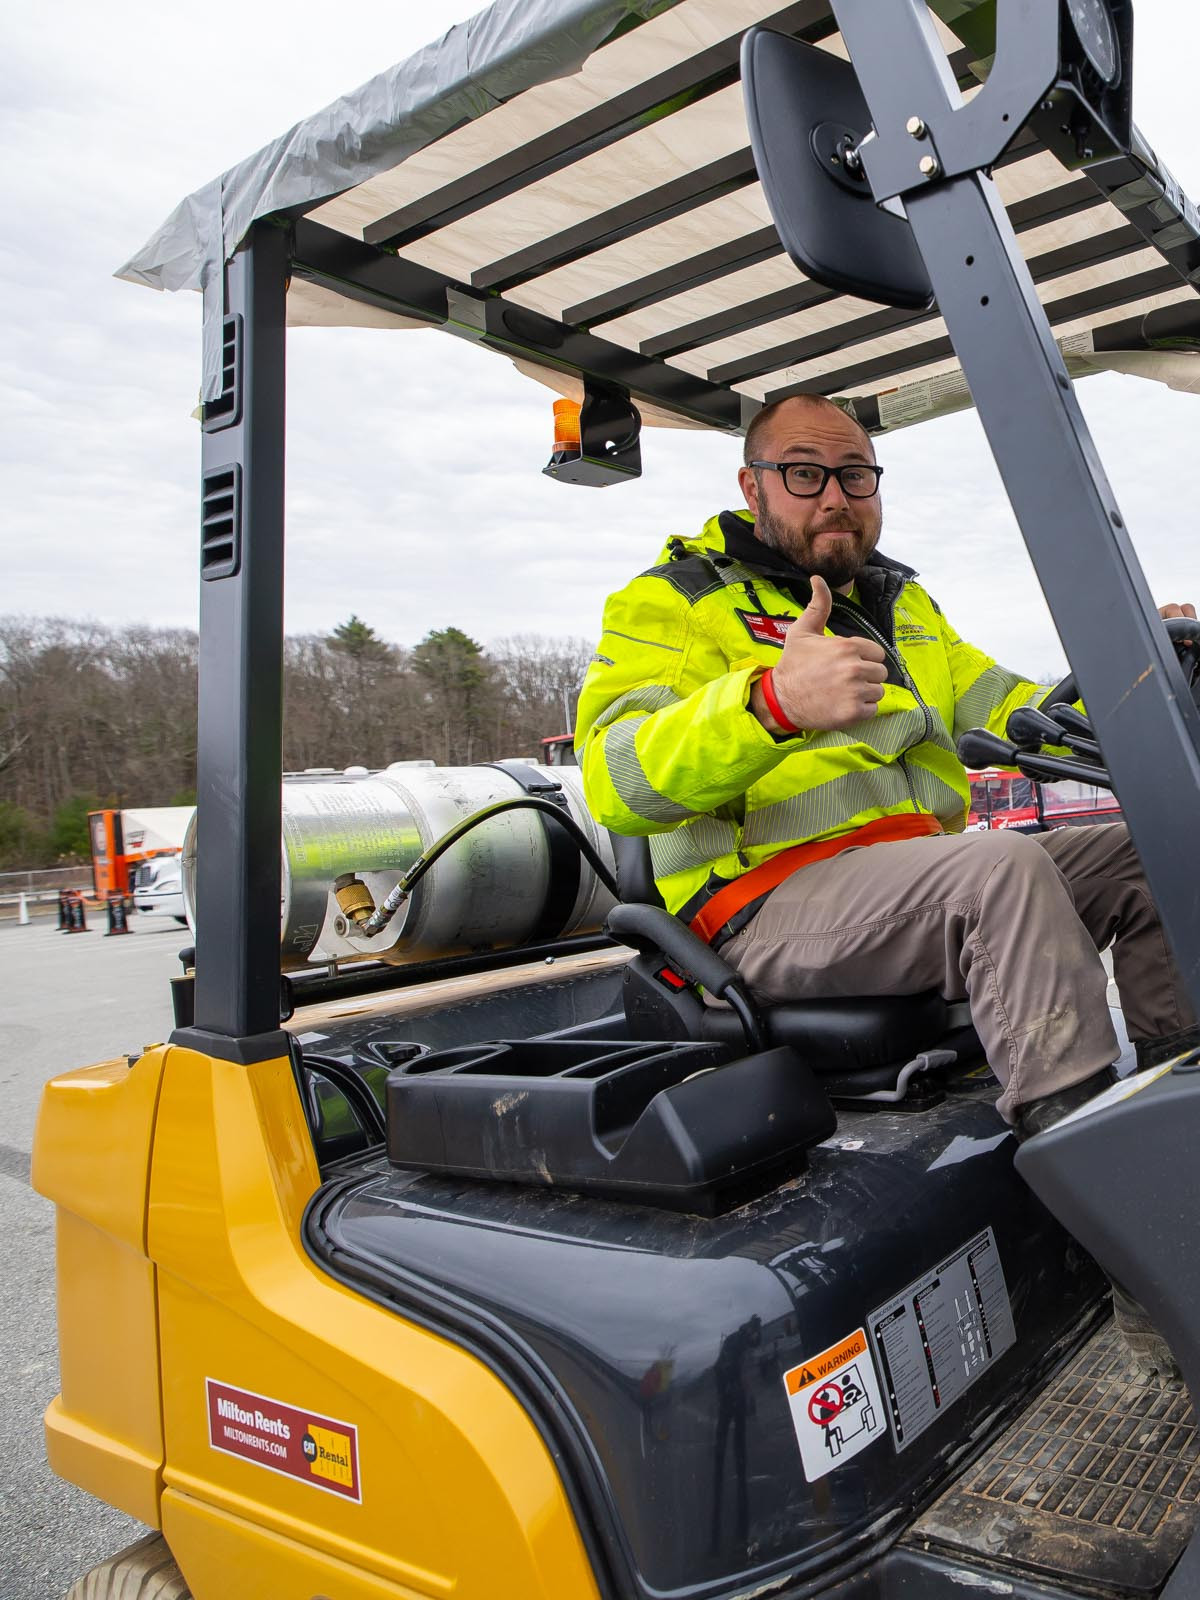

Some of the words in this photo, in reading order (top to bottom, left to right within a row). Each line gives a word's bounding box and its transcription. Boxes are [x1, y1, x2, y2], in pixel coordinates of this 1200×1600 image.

[1007, 818, 1039, 828] HONDA
[879, 1313, 895, 1329] CHECK
[817, 1342, 861, 1376] WARNING
[217, 1397, 254, 1427] Milton
[255, 1411, 291, 1440] Rents
[223, 1426, 287, 1459] MILTONRENTS.COM
[319, 1446, 349, 1467] Rental
